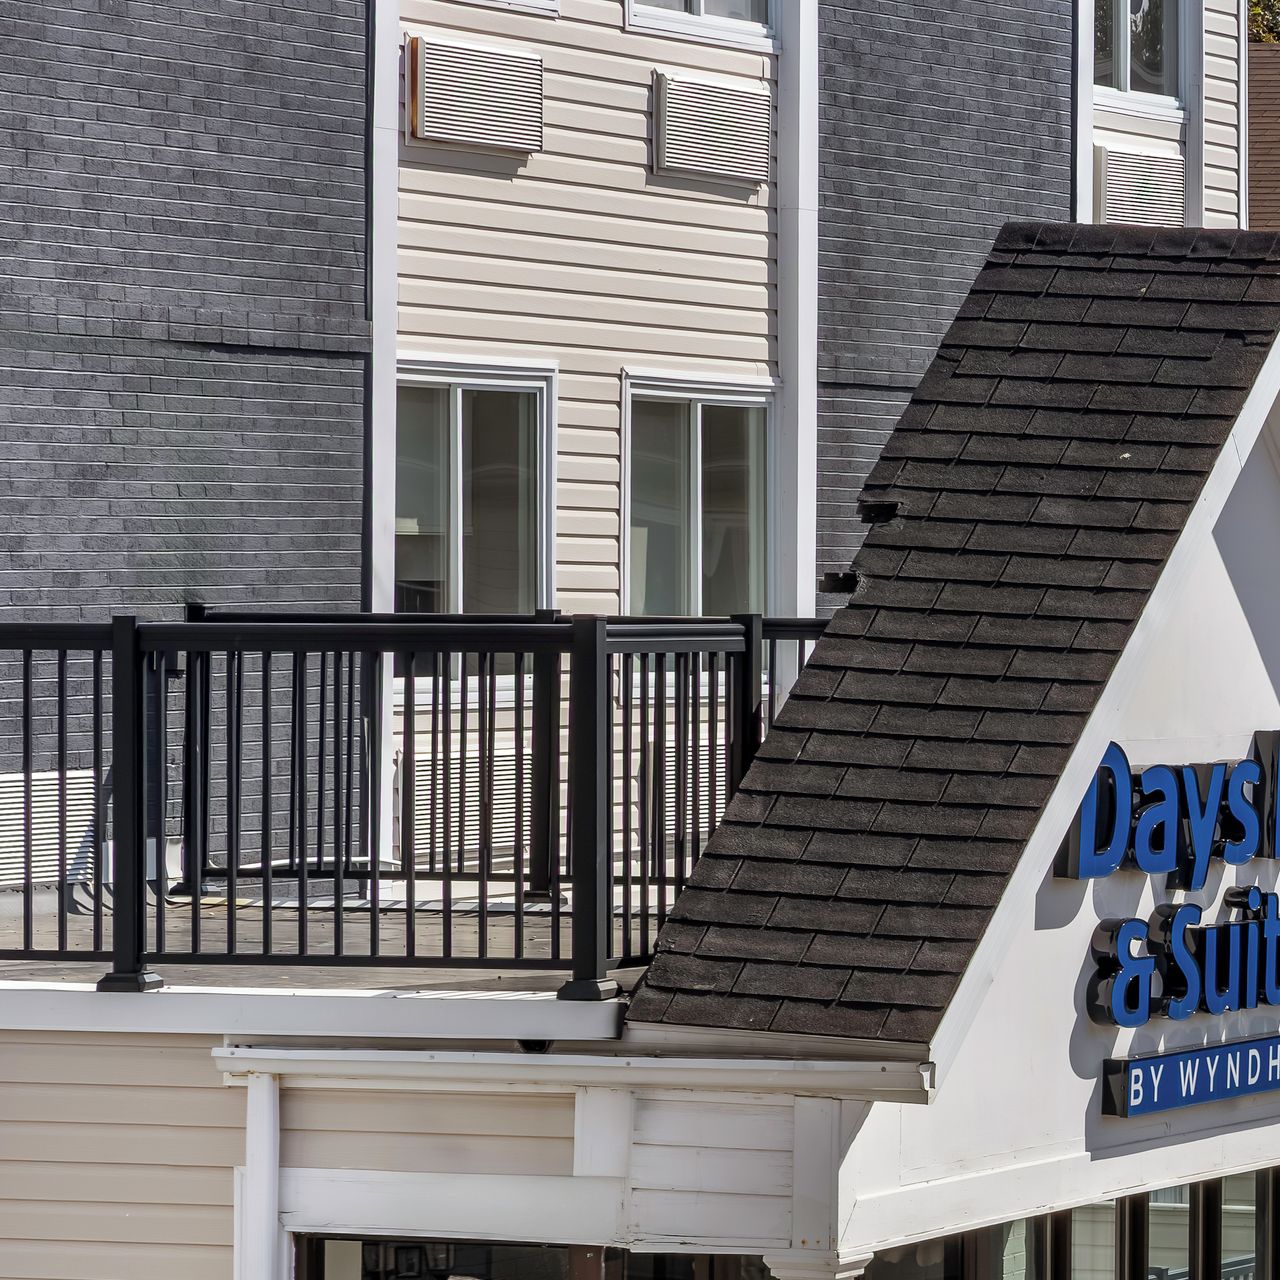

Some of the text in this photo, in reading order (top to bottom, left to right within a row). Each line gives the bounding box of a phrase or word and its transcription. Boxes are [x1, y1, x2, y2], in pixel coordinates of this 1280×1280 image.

[1074, 741, 1264, 891] Days
[1108, 917, 1156, 1029] &
[1130, 1064, 1166, 1107] BY
